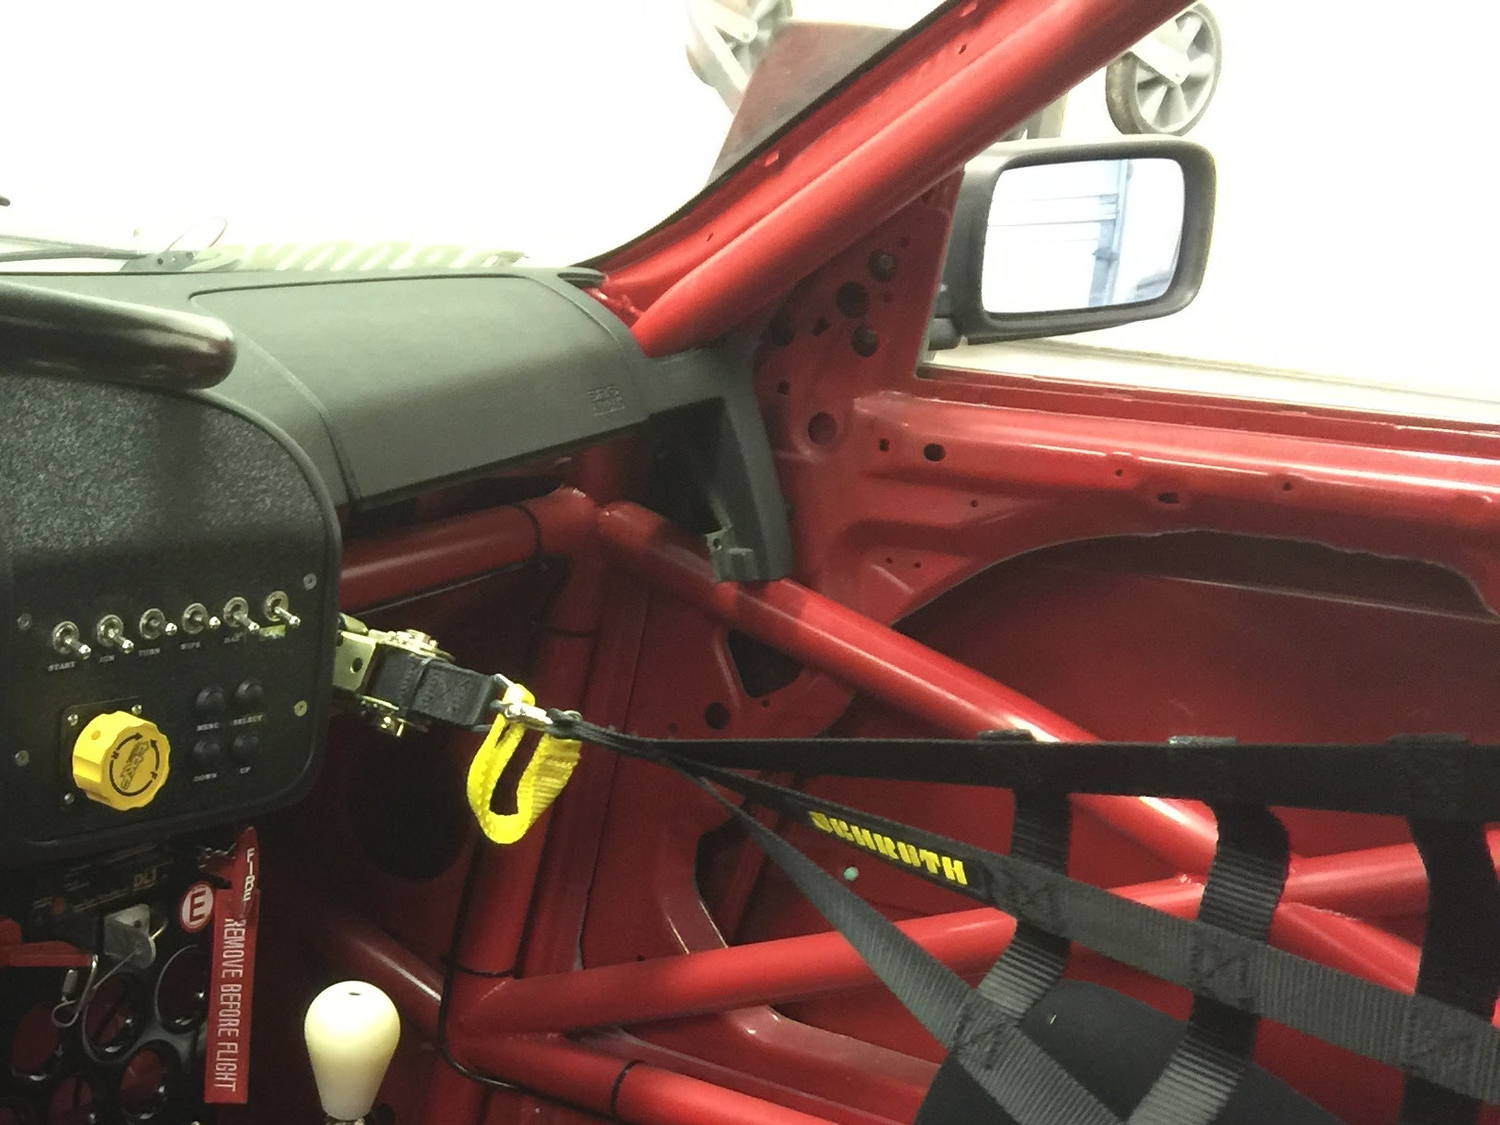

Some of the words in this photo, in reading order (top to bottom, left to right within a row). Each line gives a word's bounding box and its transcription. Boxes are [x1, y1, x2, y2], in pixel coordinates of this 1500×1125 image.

[807, 810, 969, 886] SCHROTH
[189, 889, 207, 924] E
[221, 917, 247, 979] REMOVE
[217, 983, 243, 1039] BEFORE
[213, 1041, 239, 1093] FLIGHT
